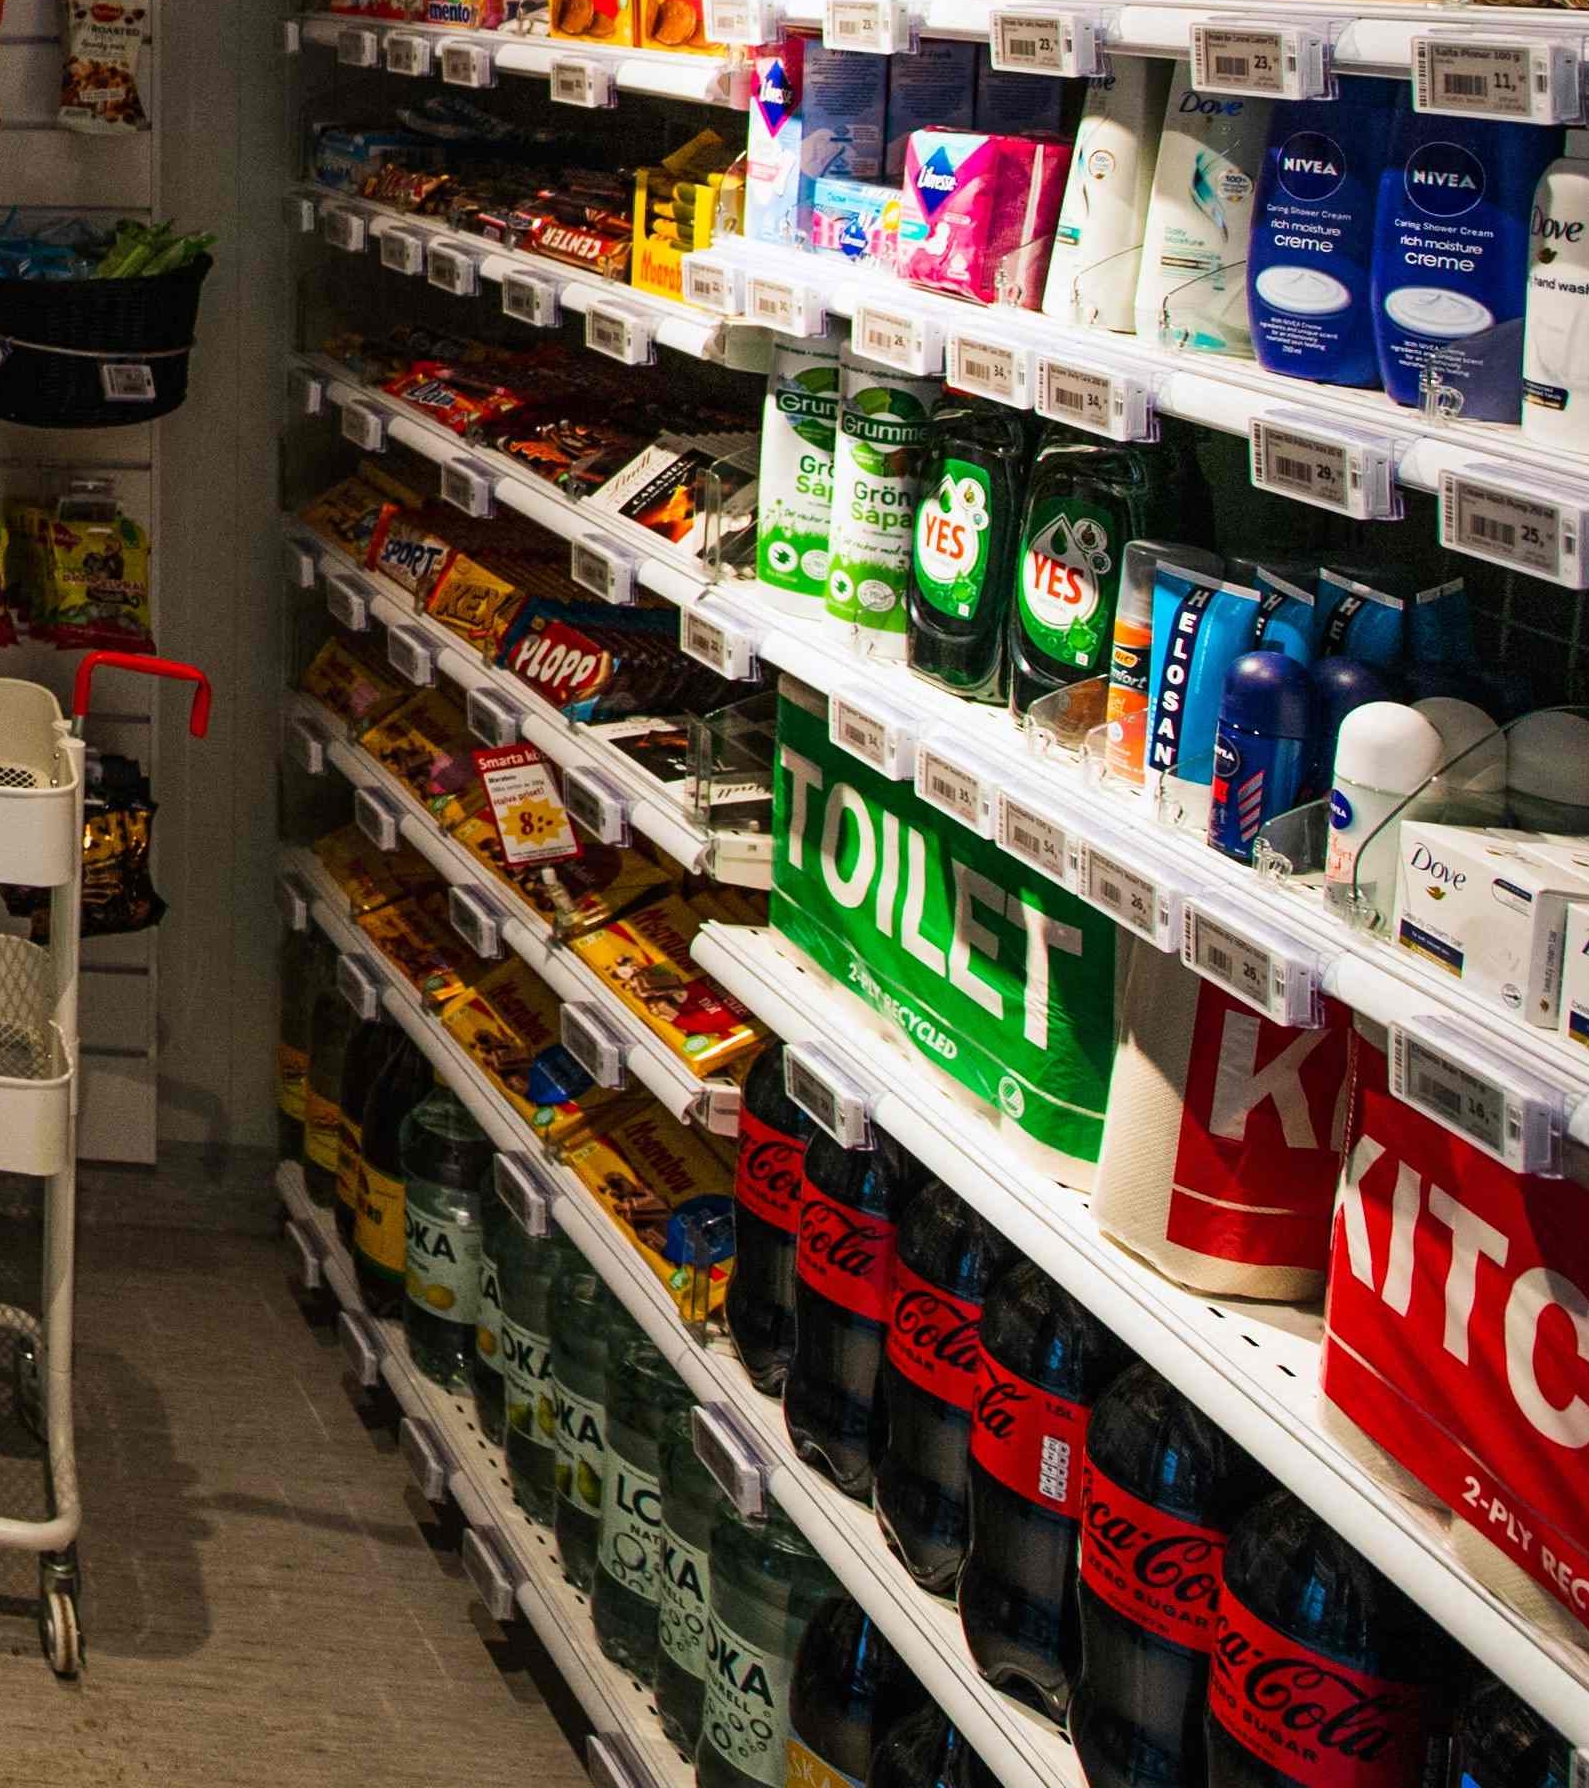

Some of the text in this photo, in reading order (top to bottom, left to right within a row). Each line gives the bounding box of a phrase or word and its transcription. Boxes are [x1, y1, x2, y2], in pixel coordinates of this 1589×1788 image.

[1179, 90, 1244, 117] Dove
[1282, 156, 1338, 177] NIVEA
[1412, 168, 1477, 190] NIVEA
[1270, 218, 1342, 237] rich moisture
[1290, 205, 1320, 218] Shower
[1320, 209, 1353, 222] Cream
[1393, 217, 1495, 240] Caring Shower Cream
[1531, 204, 1584, 243] Dove
[541, 223, 604, 258] CENTER
[1274, 233, 1334, 254] creme
[1399, 234, 1484, 256] rich moisture
[640, 257, 682, 288] Marab
[1403, 250, 1476, 274] creme
[854, 480, 911, 507] Grön
[850, 500, 912, 531] Såpa
[925, 510, 966, 562] YES
[1032, 548, 1085, 606] YES
[517, 634, 602, 689] PLOPP
[1111, 668, 1147, 690] mfort
[1153, 590, 1211, 766] HELOSAN
[477, 749, 542, 772] Smarta kö
[518, 811, 554, 837] 8:-
[1410, 841, 1468, 892] Dove
[778, 743, 1084, 1052] TOILET
[882, 988, 959, 1062] RECYCLED
[405, 1213, 457, 1265] OKA
[1338, 1131, 1589, 1452] KITC
[894, 1289, 982, 1376] Cola
[502, 1330, 554, 1381] OKA
[555, 1393, 606, 1450] OKA
[1461, 1474, 1534, 1553] 2-PLY
[1131, 1589, 1210, 1632] SUGAR
[1215, 1614, 1395, 1764] ca-Cola
[1241, 1711, 1319, 1766] SUGAR
